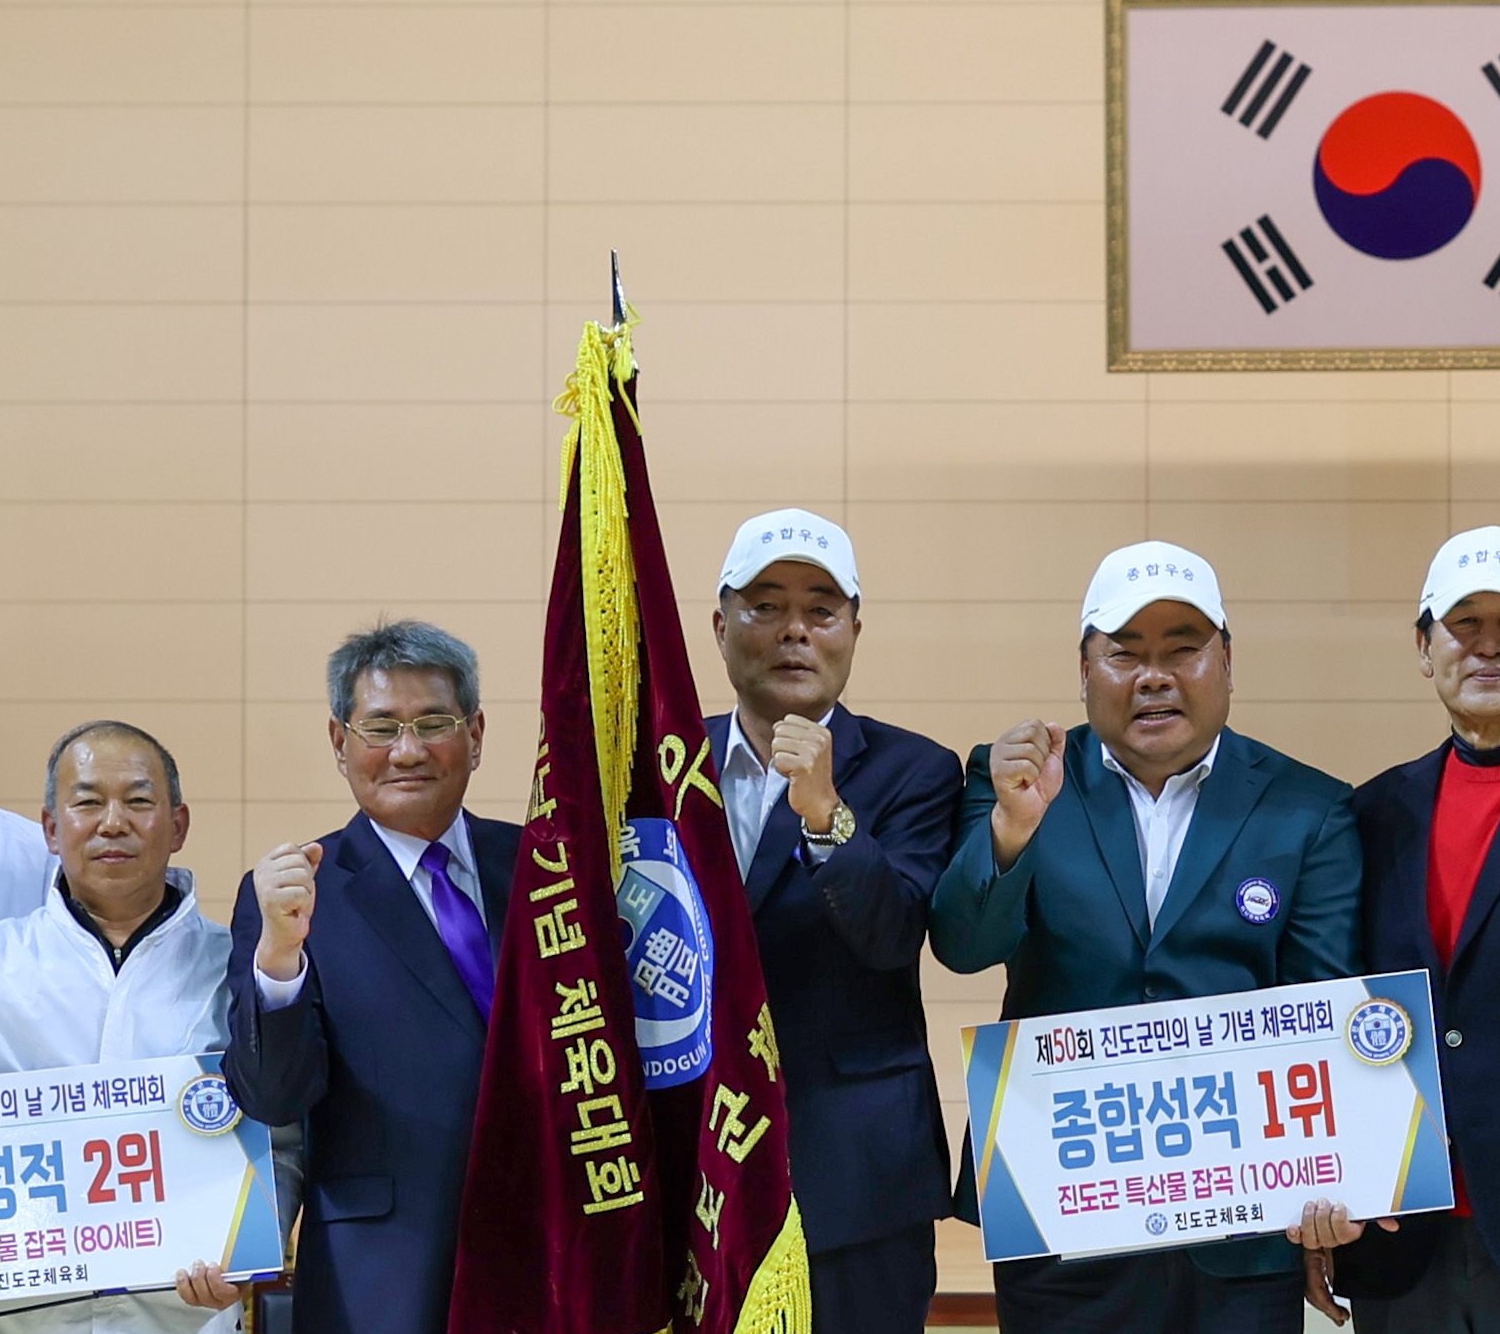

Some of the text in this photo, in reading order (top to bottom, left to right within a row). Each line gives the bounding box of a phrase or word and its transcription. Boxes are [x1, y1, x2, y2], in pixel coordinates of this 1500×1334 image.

[761, 527, 829, 549] 종합우승
[1126, 563, 1194, 582] 종합우승
[528, 841, 587, 959] 기념
[1034, 1000, 1334, 1065] 제50회 진도군민의 날 기념 체육대회
[24, 1087, 44, 1117] 날
[50, 1083, 86, 1114] 기념
[92, 1075, 166, 1109] 체육대회
[551, 978, 645, 1216] 체육대회
[1051, 1060, 1336, 1169] 종합성적 1위
[83, 1130, 165, 1205] 2위
[1058, 1153, 1342, 1216] 진도군 특산물 잡곡 (100세트)
[24, 1229, 68, 1258] 잡곡
[73, 1218, 162, 1254] (80세트)
[1175, 1203, 1264, 1231] 진도군체육회
